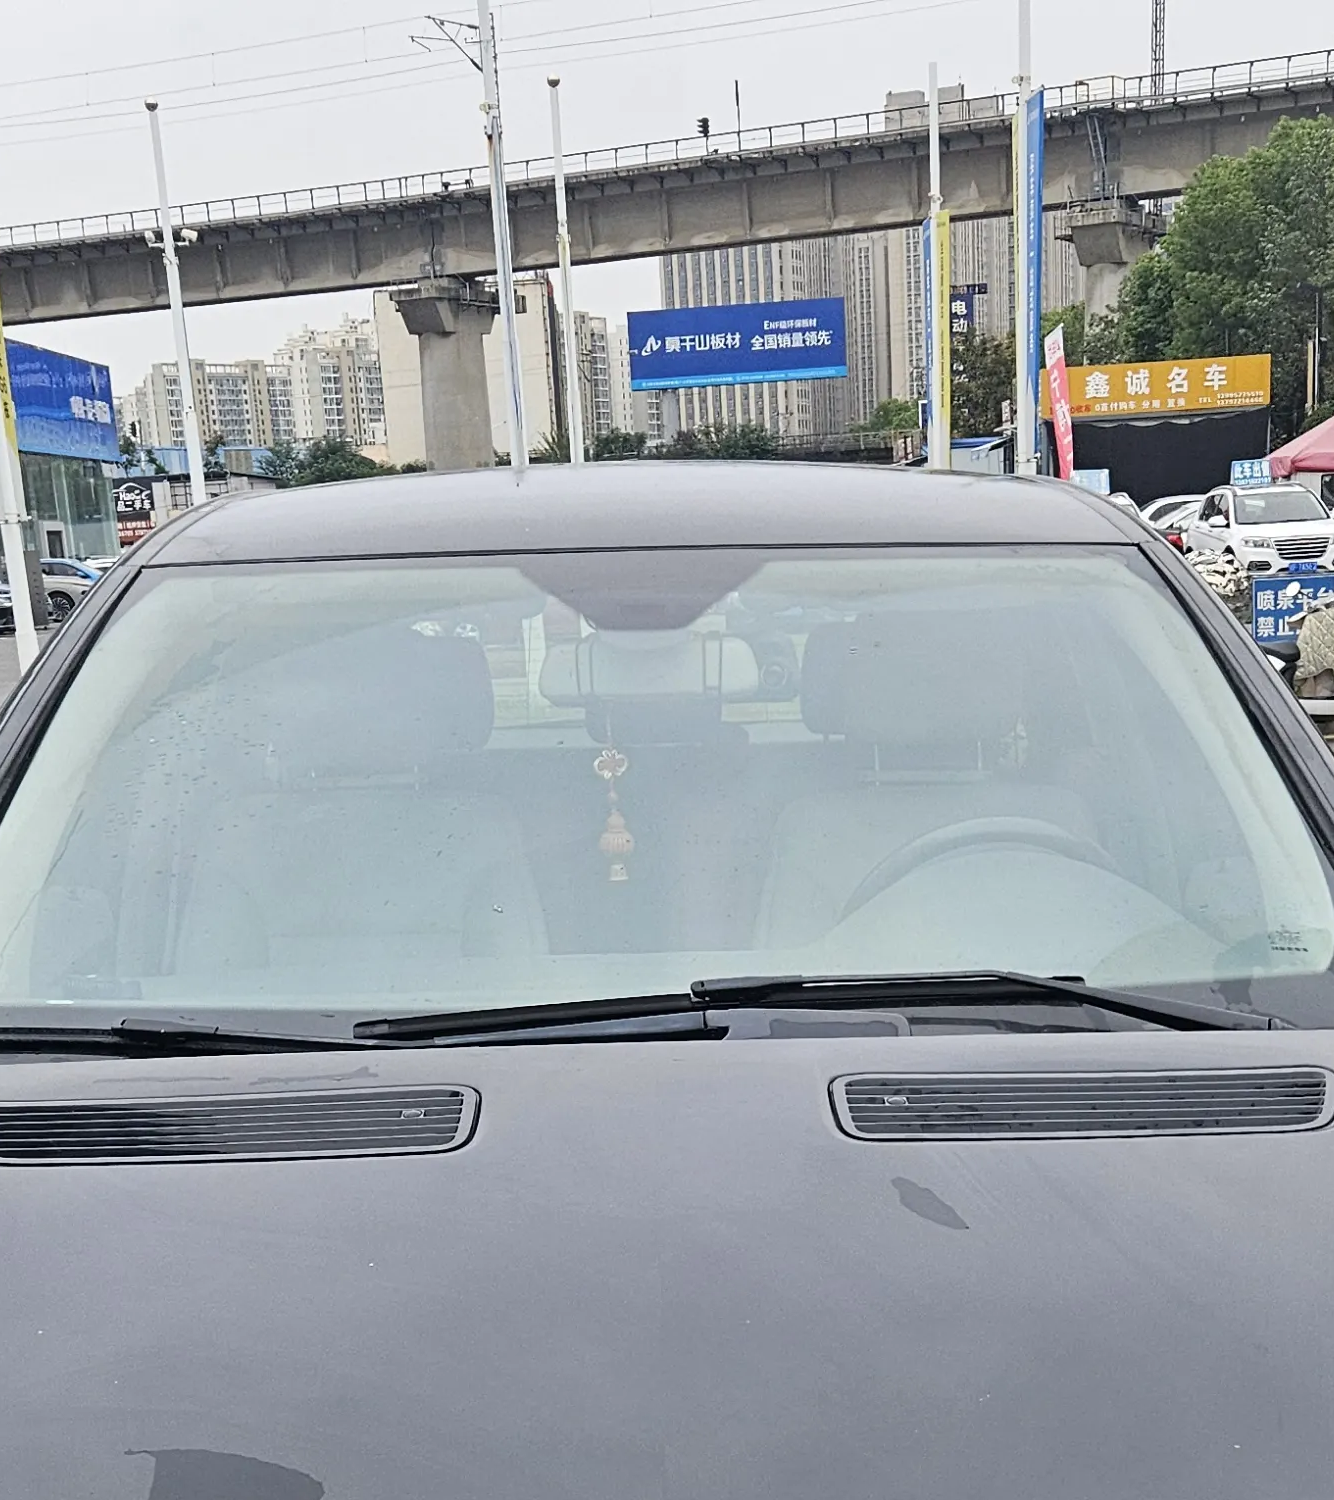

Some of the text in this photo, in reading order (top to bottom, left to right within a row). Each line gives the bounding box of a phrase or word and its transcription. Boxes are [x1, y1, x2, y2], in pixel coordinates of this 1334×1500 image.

[665, 332, 741, 353] 莫干山板材
[750, 330, 832, 351] 全国销量领先
[1085, 363, 1228, 399] 鑫诚名车
